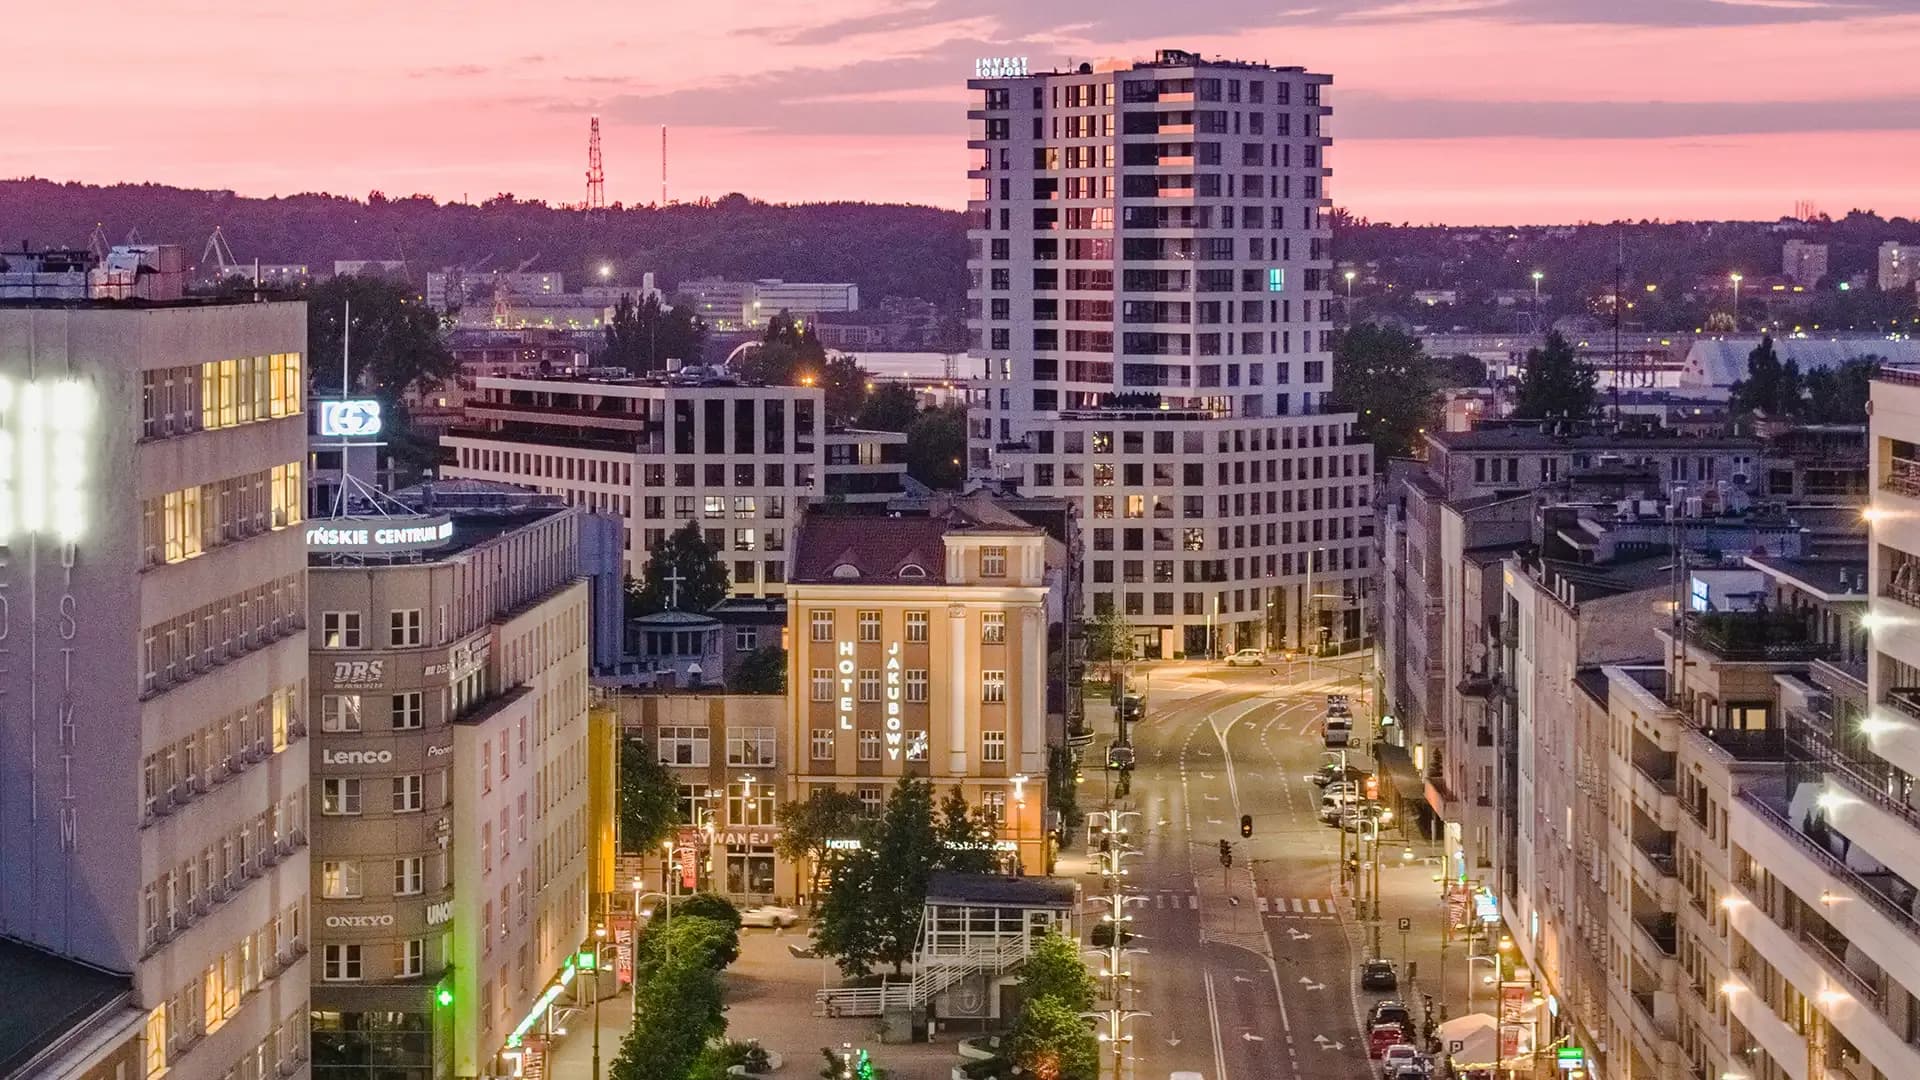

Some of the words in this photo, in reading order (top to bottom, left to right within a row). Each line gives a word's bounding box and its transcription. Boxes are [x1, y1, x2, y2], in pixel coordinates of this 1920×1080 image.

[976, 57, 1027, 68] INVEST
[374, 526, 437, 544] CENTRUM
[839, 641, 854, 730] HOTEL
[886, 641, 901, 760] JAKUBOWY
[323, 749, 392, 764] Lenco
[326, 915, 394, 927] ONKYO
[1400, 918, 1409, 929] P
[1452, 1042, 1462, 1053] P
